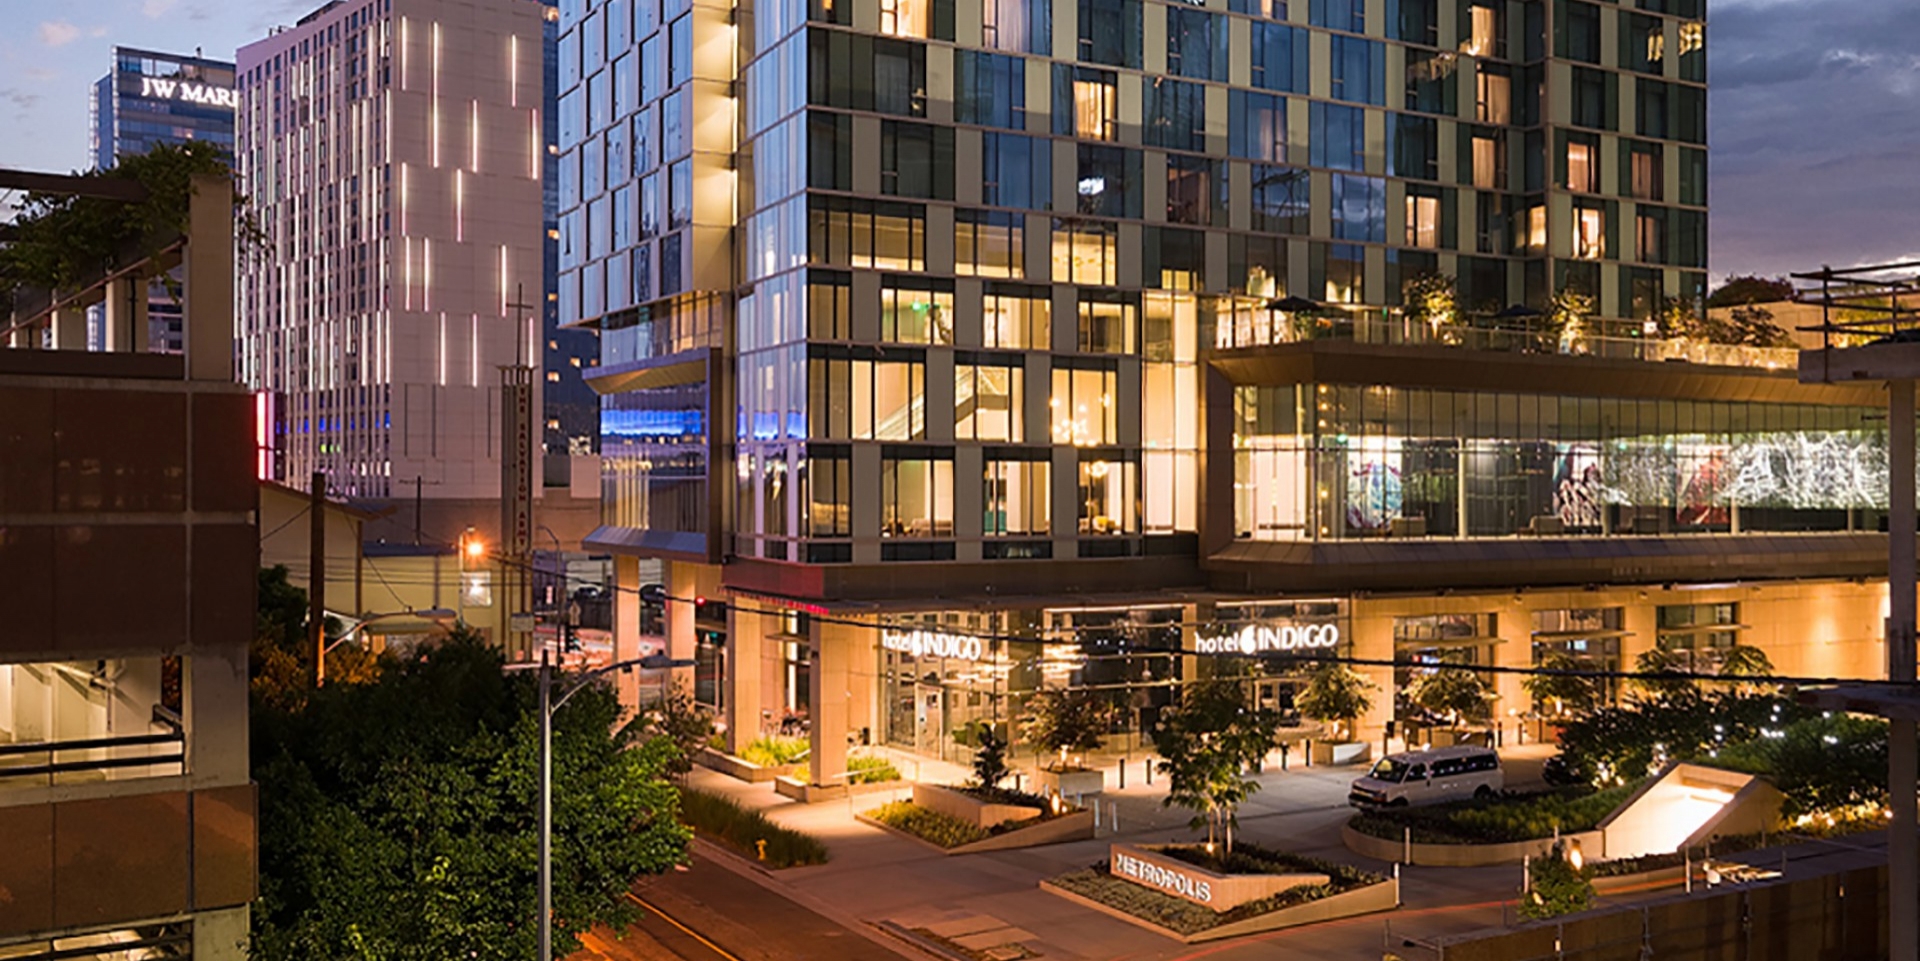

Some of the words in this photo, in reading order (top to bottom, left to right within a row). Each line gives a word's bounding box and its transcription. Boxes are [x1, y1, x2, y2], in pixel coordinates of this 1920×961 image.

[141, 78, 176, 99] JW
[518, 386, 527, 414] THE
[518, 422, 527, 502] SALVATION
[517, 511, 527, 547] ARMY
[882, 629, 913, 652] hotel
[923, 630, 981, 660] INDIGO
[1194, 631, 1239, 654] hotel
[1257, 623, 1338, 650] INDIGO
[1116, 853, 1212, 902] METROPOLIS
